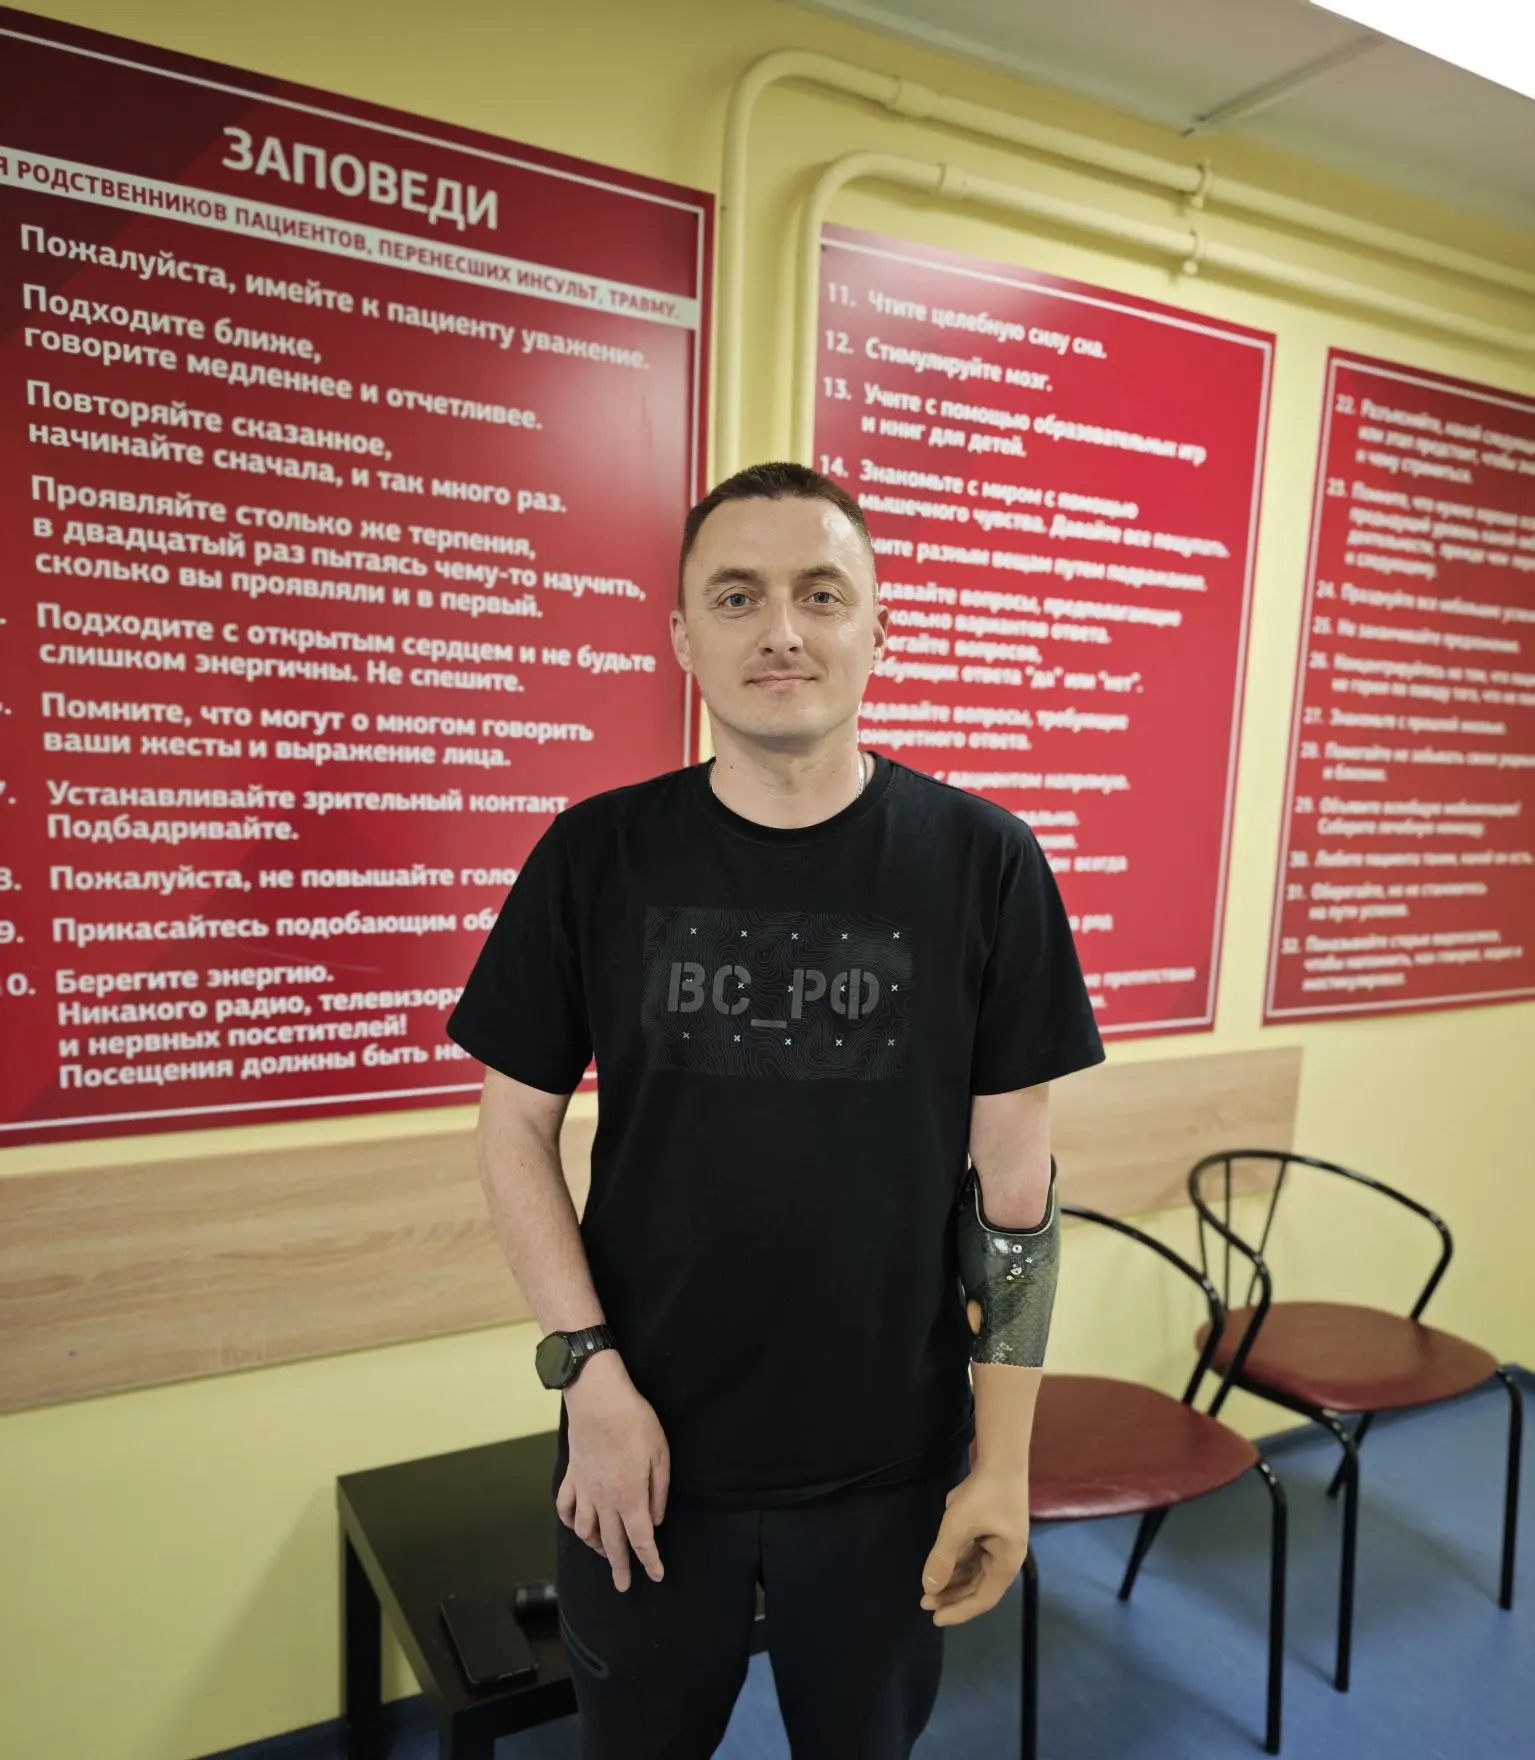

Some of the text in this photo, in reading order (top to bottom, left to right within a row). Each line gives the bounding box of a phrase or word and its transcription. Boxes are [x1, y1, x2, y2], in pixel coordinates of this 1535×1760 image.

[221, 126, 497, 230] ЗАПОВЕДИ
[17, 160, 228, 222] РОДСТВЕННИКОВ
[235, 207, 373, 254] ПАЦИЕНТОВ,
[378, 239, 512, 282] ПЕРЕНЕСШИХ
[517, 270, 603, 304] ИНСУЛЬТ,
[609, 290, 680, 319] ТРАВМУ.
[20, 223, 650, 369] Пожалуйста, имейте к пациенту уважение.
[22, 282, 321, 364] Подходите ближе,
[827, 281, 856, 306] 11.
[868, 289, 927, 321] Чтите
[931, 307, 1025, 342] целебную
[1027, 326, 1070, 355] силу
[24, 326, 543, 429] говорите медленнее и отчетливее.
[825, 329, 1053, 392] 12. Стимулируйте мозг.
[26, 378, 392, 461] Повторяйте сказанное,
[823, 374, 853, 400] 13.
[863, 381, 922, 412] Учите
[924, 397, 937, 415] с
[860, 415, 1027, 457] и книг для детей.
[28, 423, 567, 513] начинайте сначала, и так много раз.
[819, 453, 848, 478] 14.
[858, 458, 964, 494] Знакомьте
[966, 479, 978, 496] с
[1042, 489, 1056, 508] с
[31, 474, 536, 560] Проявляйте столько же терпения,
[33, 516, 646, 601] в двадцатый раз пытаясь чему-то научить,
[35, 552, 543, 618] сколько вы проявляли и в первый.
[36, 601, 656, 673] Подходите с открытым сердцем и не будьте
[38, 643, 524, 692] слишком энергичны. Не спешите.
[41, 691, 594, 743] Помните, что могут о многом говорить
[43, 731, 511, 769] ваши жесты и выражение лица.
[46, 779, 569, 813] Устанавливайте зрительный контакт
[47, 813, 299, 844] Подбадривайте.
[49, 864, 251, 895] Пожалуйста,
[258, 869, 294, 888] не
[300, 863, 454, 887] повышайте
[460, 867, 518, 886] голо
[51, 914, 269, 948] Прикасайтесь
[275, 909, 457, 939] подобающим
[0, 963, 334, 998] 0. Берегите энергию.
[57, 999, 207, 1025] Никакого
[214, 995, 311, 1023] радио,
[667, 961, 881, 1029] ВС_РФ
[58, 1012, 407, 1059] и нервных посетителей!
[59, 1058, 233, 1089] Посещения
[239, 1050, 356, 1079] должны
[361, 1042, 429, 1067] быть
